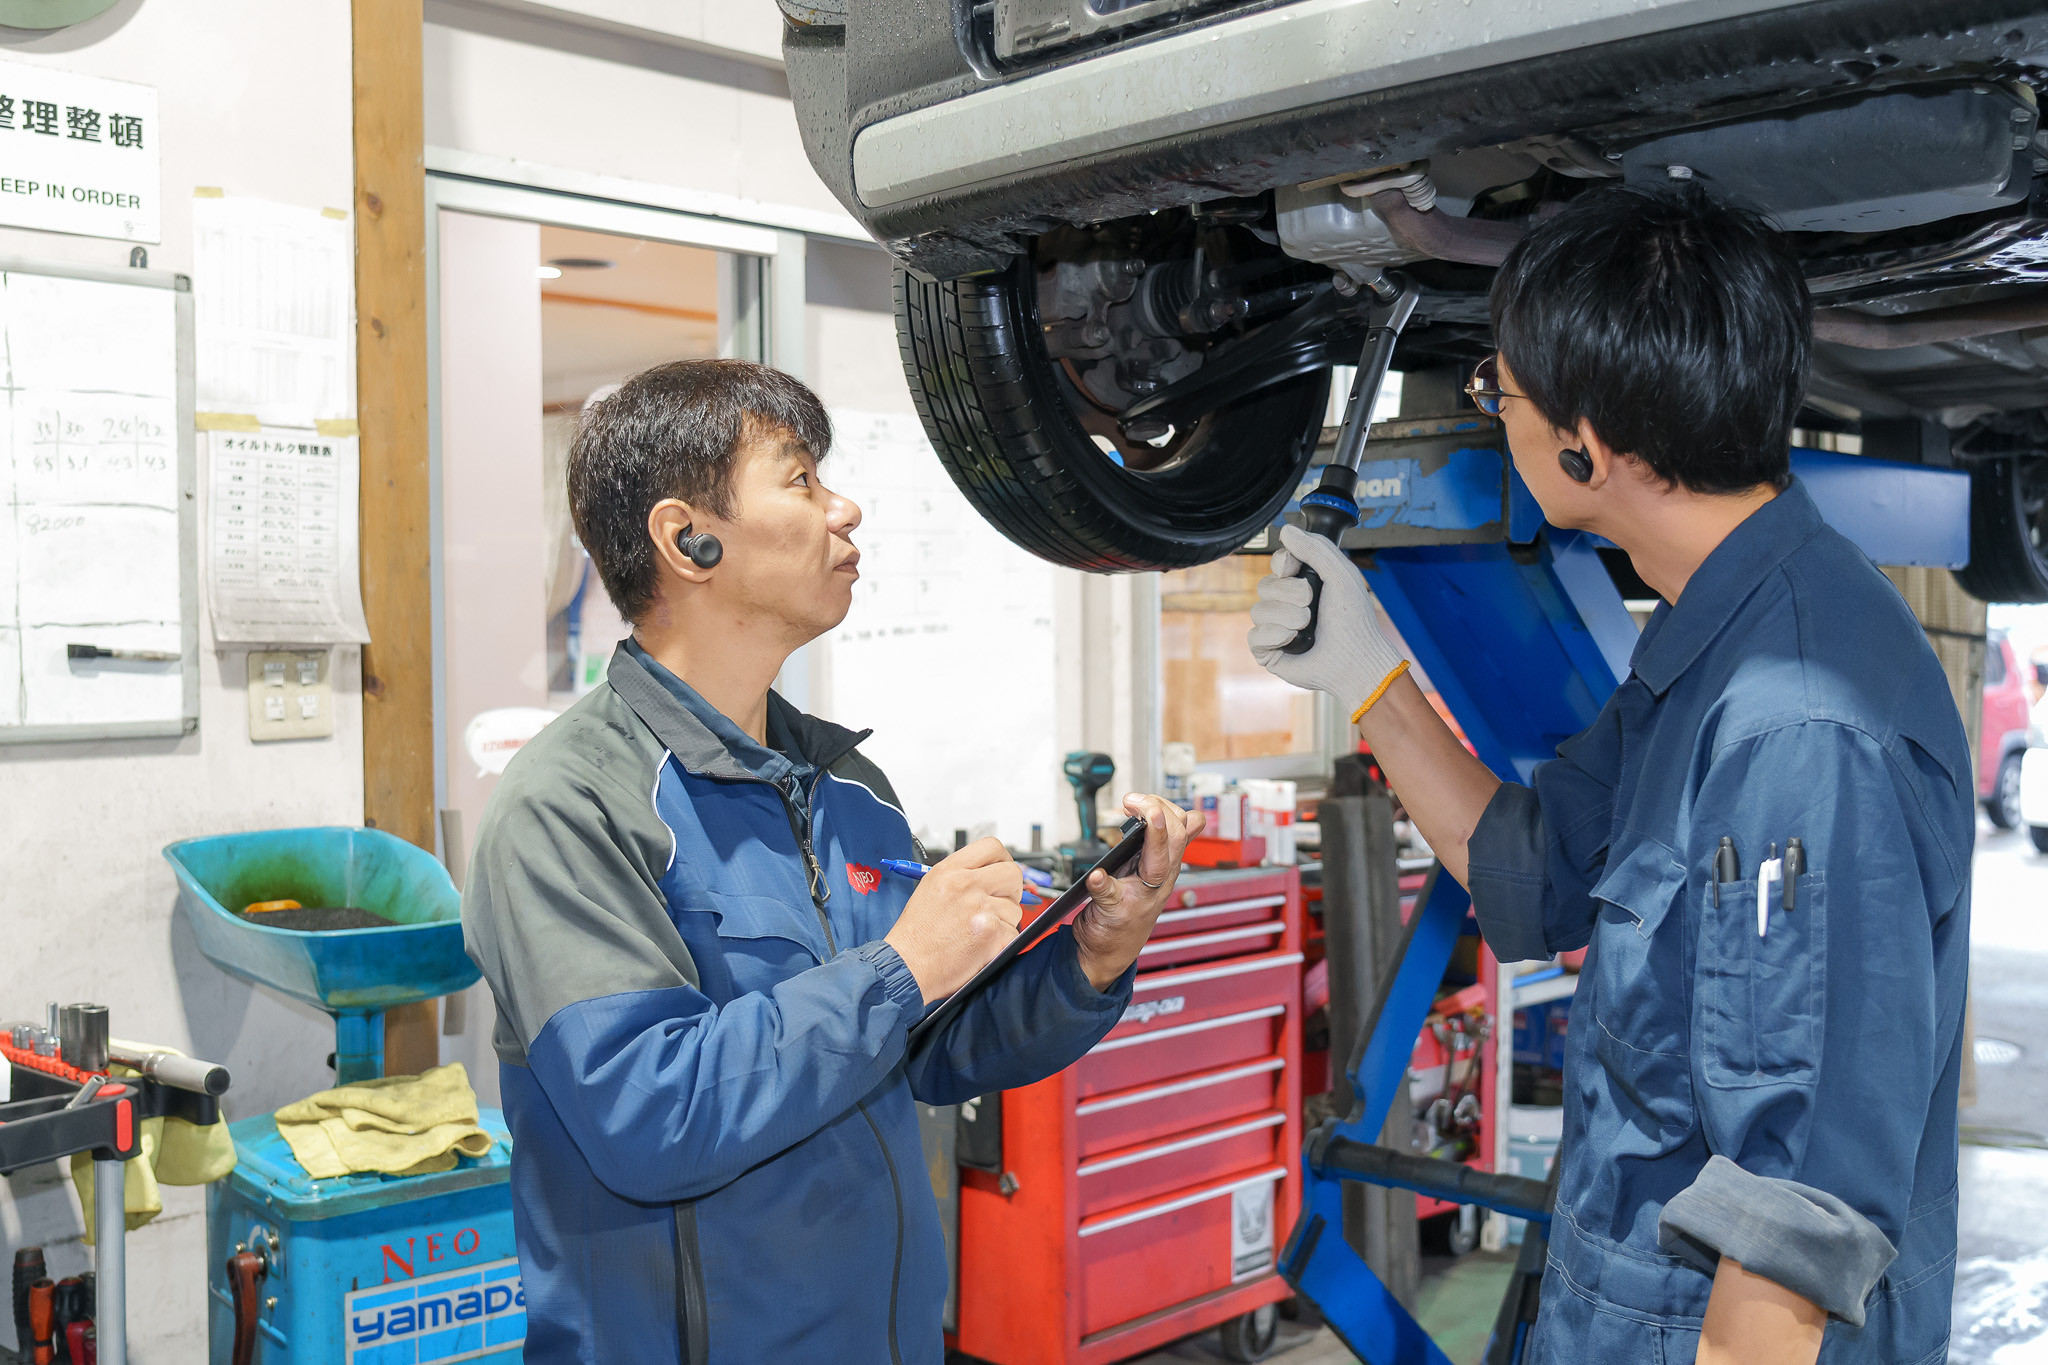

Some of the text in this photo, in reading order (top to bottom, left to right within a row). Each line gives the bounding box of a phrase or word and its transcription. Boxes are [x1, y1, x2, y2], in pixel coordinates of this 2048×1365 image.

[46, 183, 65, 200] IN
[72, 187, 141, 210] ORDER
[852, 871, 875, 889] NEO
[379, 1227, 482, 1284] NEO
